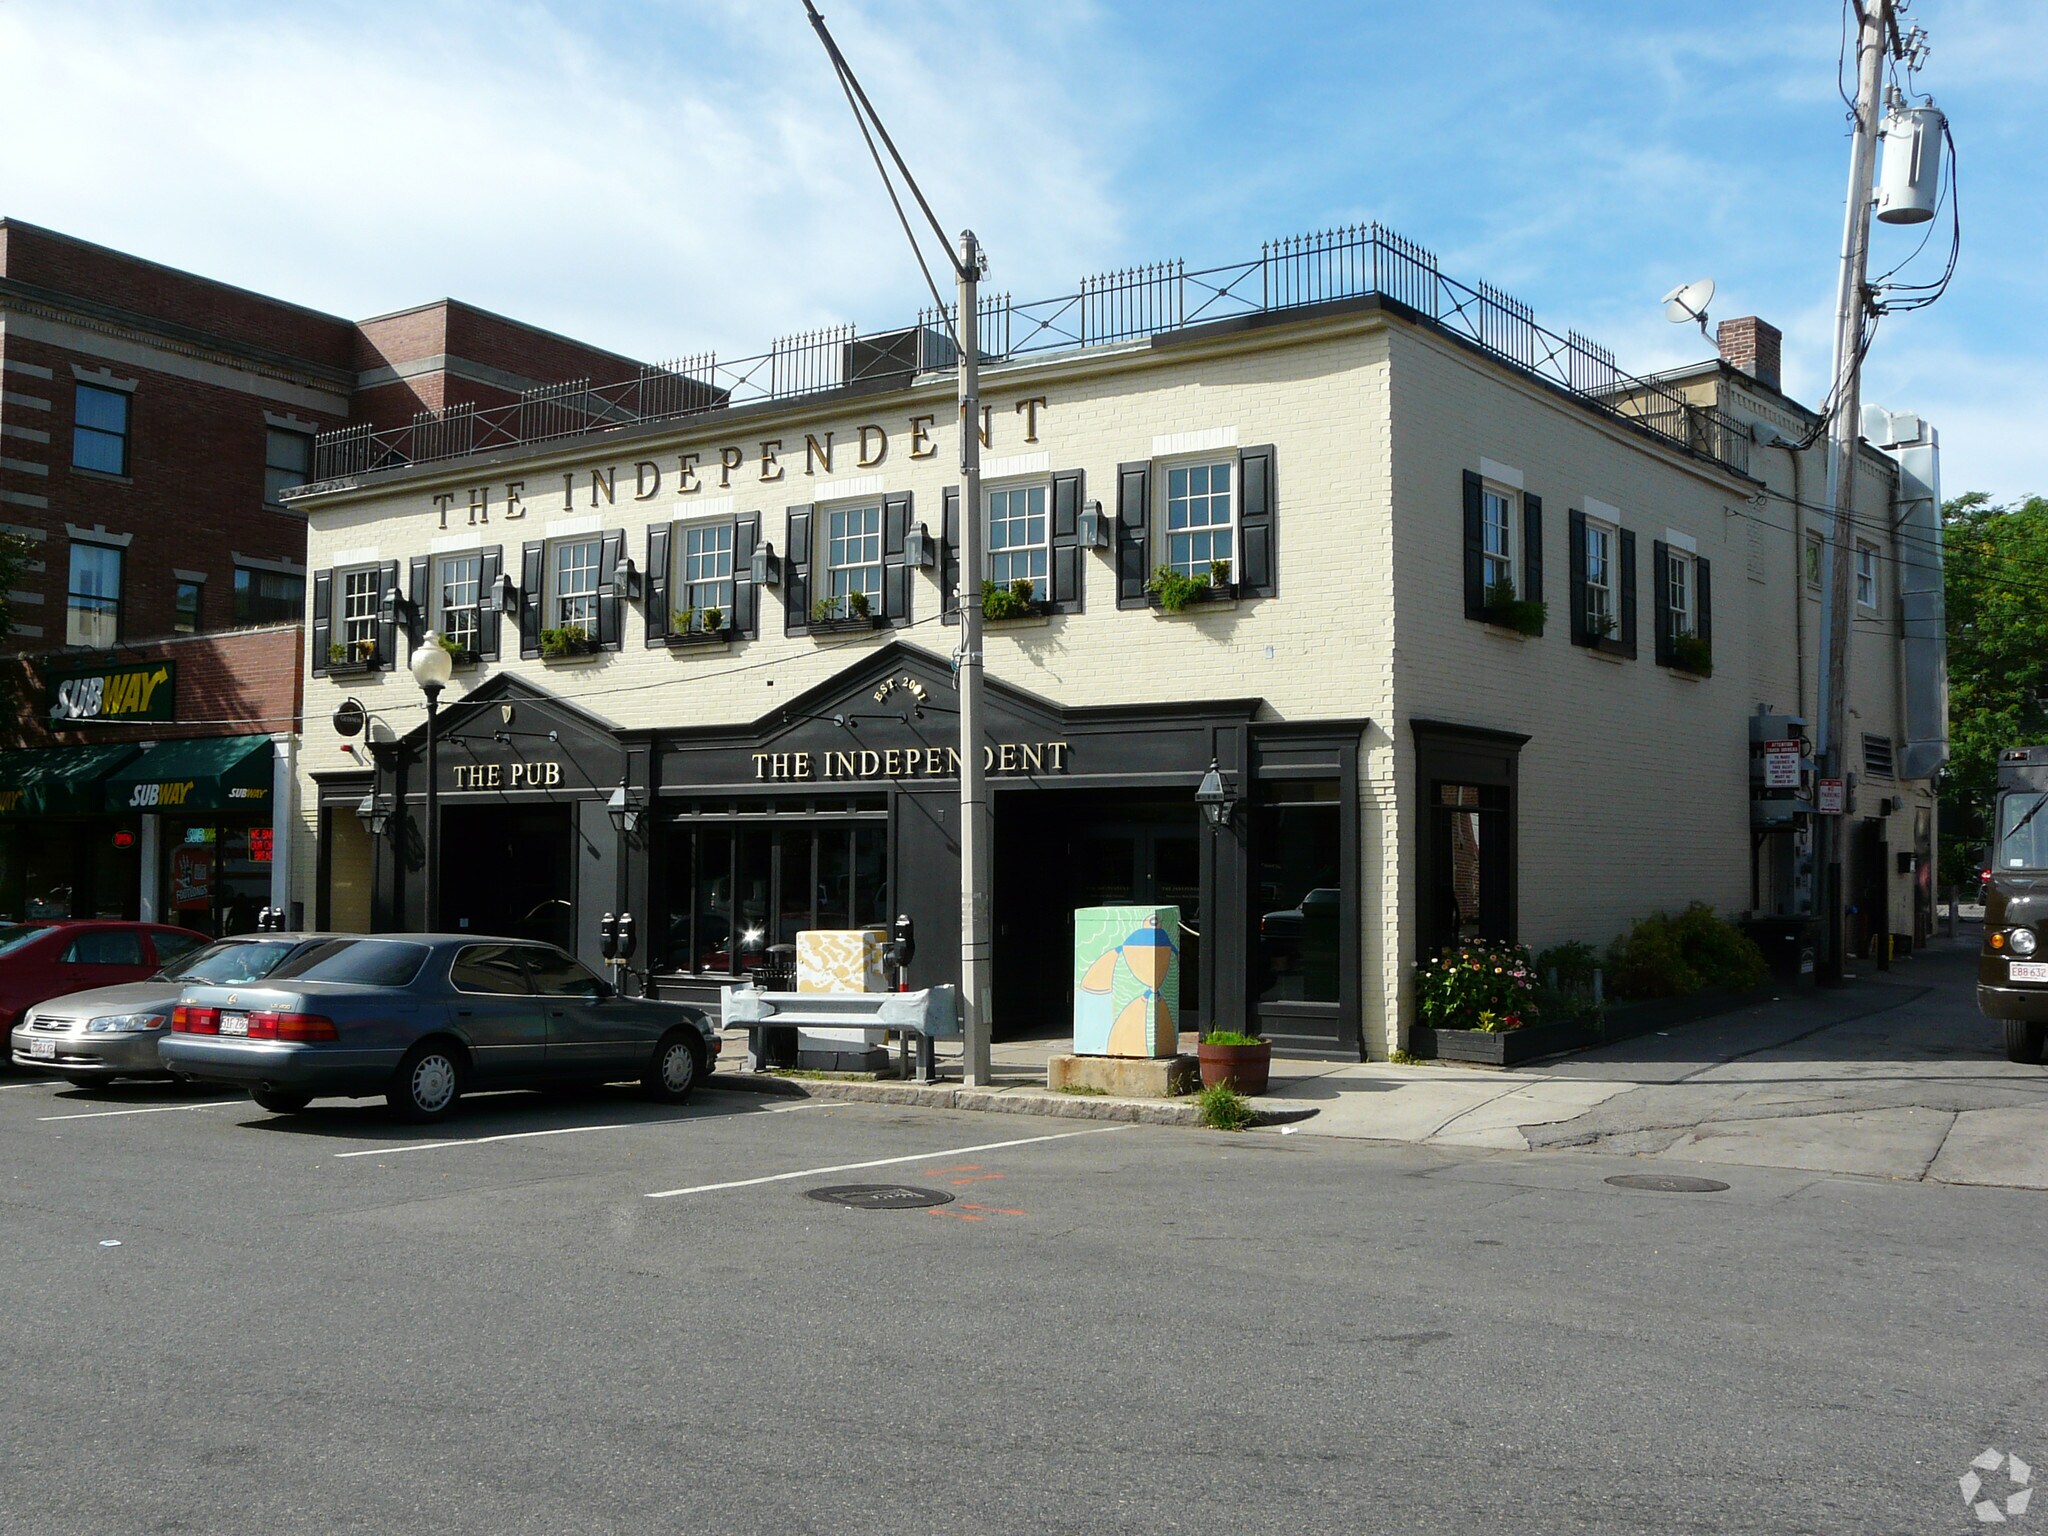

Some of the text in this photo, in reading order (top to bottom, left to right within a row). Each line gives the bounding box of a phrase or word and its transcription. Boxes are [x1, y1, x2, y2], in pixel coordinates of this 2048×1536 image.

[433, 481, 526, 529] THE
[50, 666, 168, 719] SUBWAY
[873, 677, 927, 702] EST. 2001
[453, 762, 561, 788] THE PUB
[752, 752, 809, 778] THE
[129, 781, 194, 807] SUBWAY
[228, 788, 268, 799] SUBWAY
[184, 828, 229, 843] SUBWA
